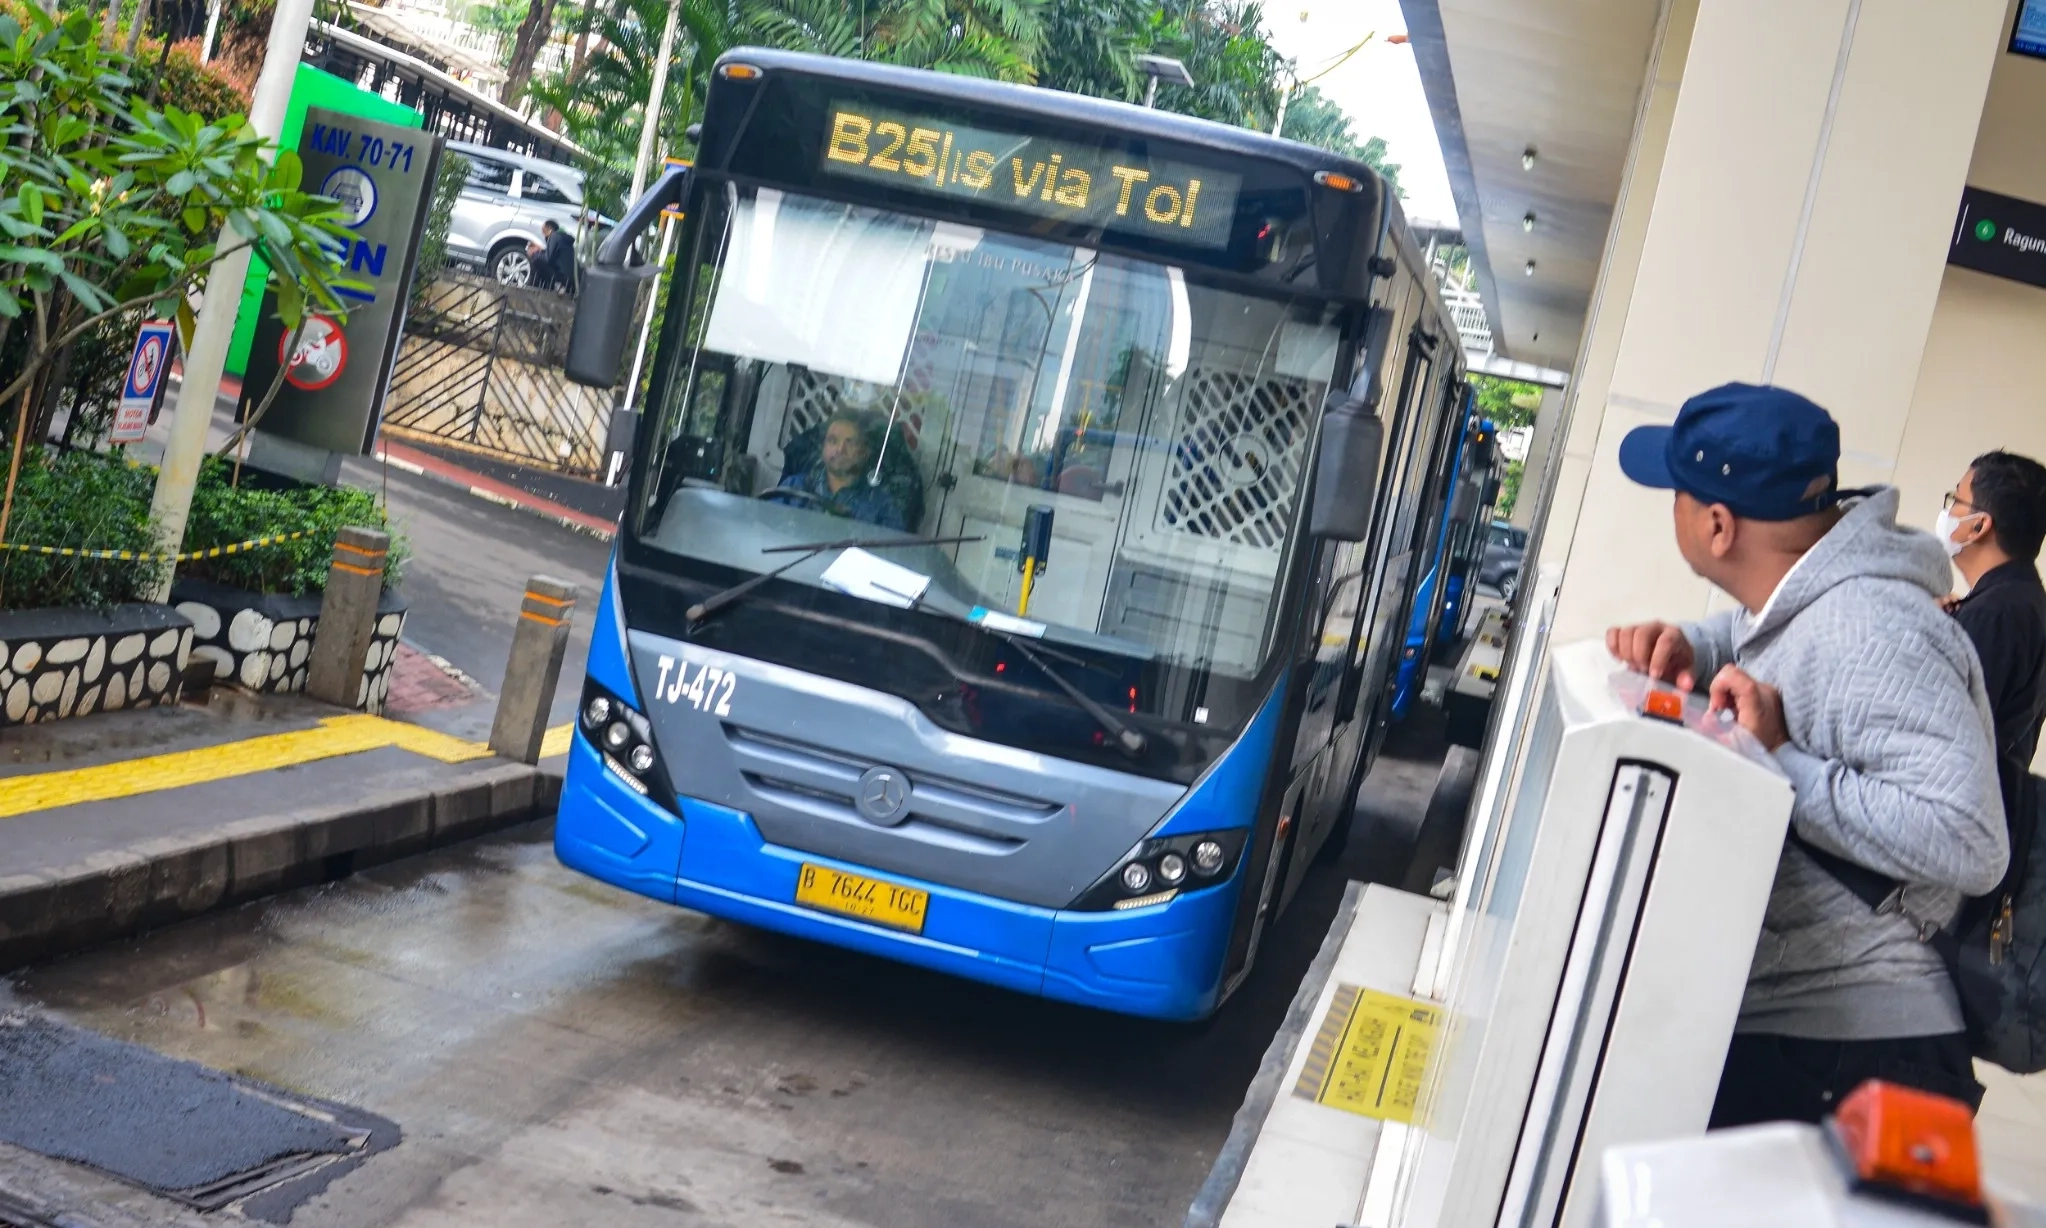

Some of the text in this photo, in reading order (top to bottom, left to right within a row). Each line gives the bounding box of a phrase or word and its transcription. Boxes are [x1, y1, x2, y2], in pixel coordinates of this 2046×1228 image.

[311, 122, 414, 173] KAV. 70-71
[1011, 153, 1091, 208] via
[1112, 165, 1201, 228] Tol
[2003, 227, 2046, 254] Ragun
[655, 654, 736, 717] TJ-472
[803, 867, 816, 889] B
[831, 872, 877, 904] 7644
